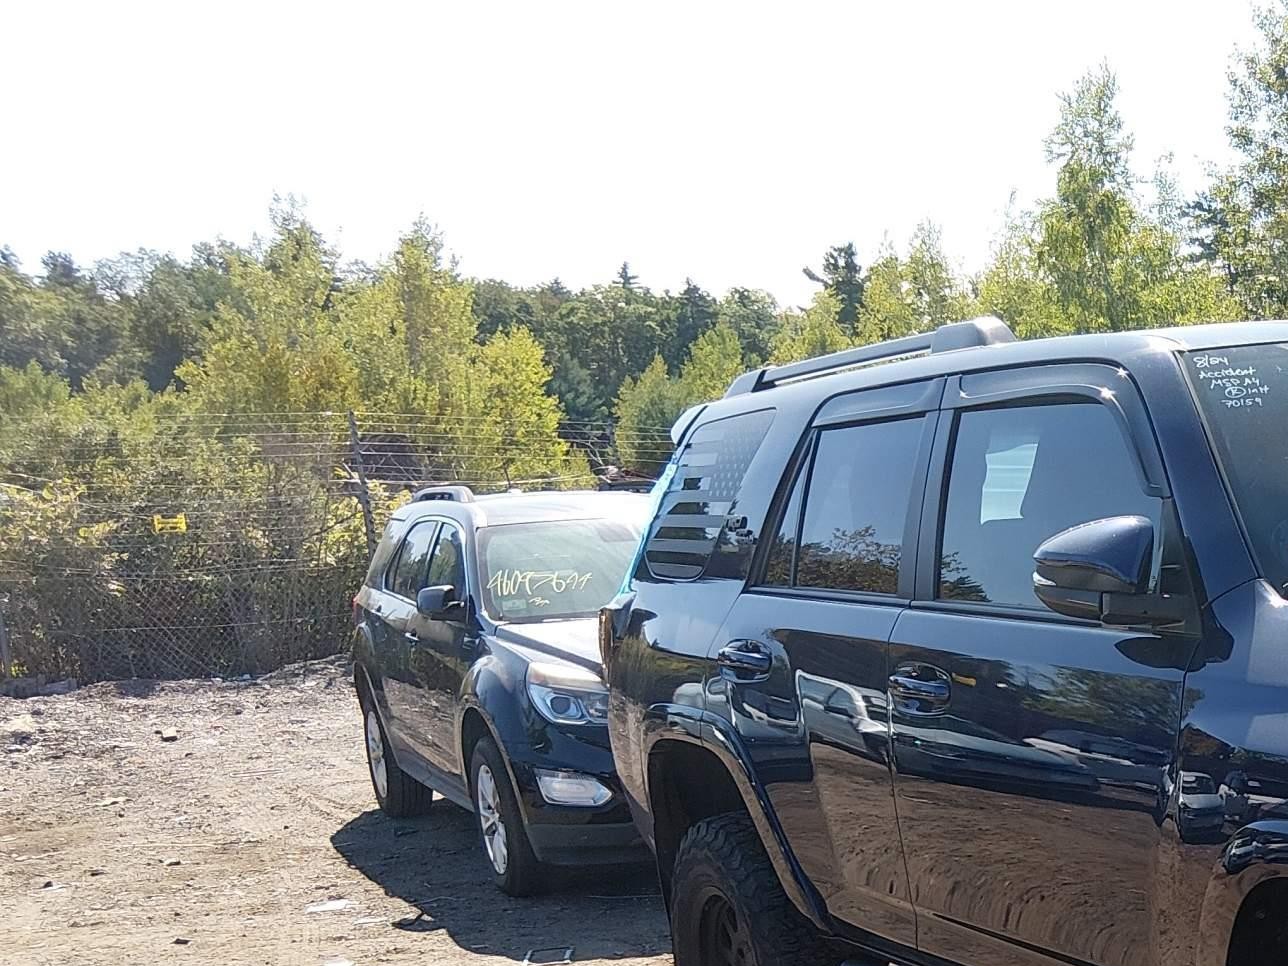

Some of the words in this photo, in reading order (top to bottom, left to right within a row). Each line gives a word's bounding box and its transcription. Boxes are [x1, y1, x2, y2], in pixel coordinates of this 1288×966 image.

[1193, 354, 1229, 368] 8/24
[1198, 365, 1257, 380] Accident
[1220, 397, 1263, 409] 70159
